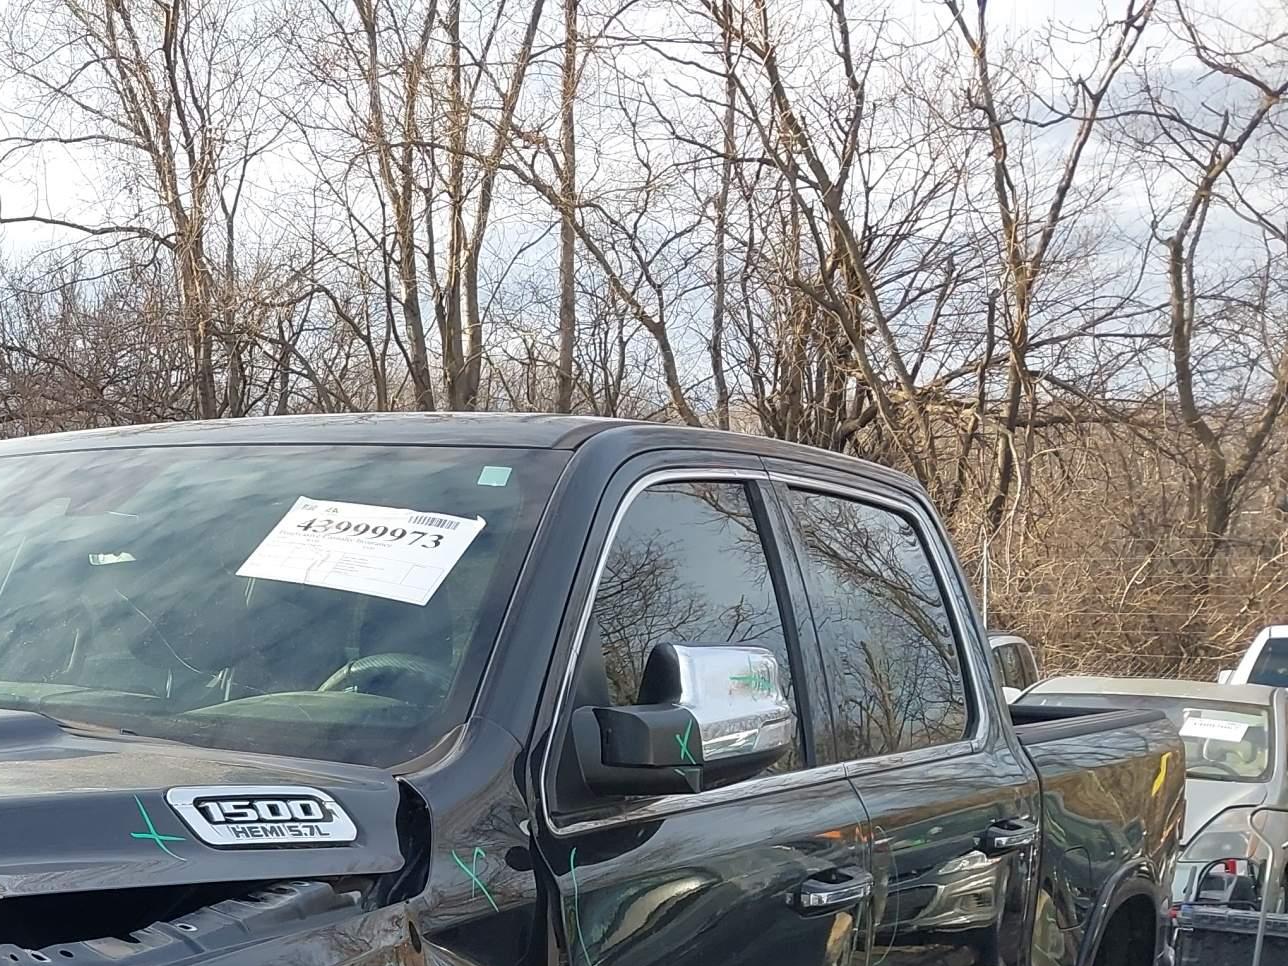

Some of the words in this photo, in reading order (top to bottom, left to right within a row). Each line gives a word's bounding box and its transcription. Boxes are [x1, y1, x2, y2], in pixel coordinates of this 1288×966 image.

[297, 518, 444, 549] 43999973
[199, 800, 324, 822] 1500
[233, 824, 286, 839] HEMI
[287, 823, 330, 838] 5.7L
